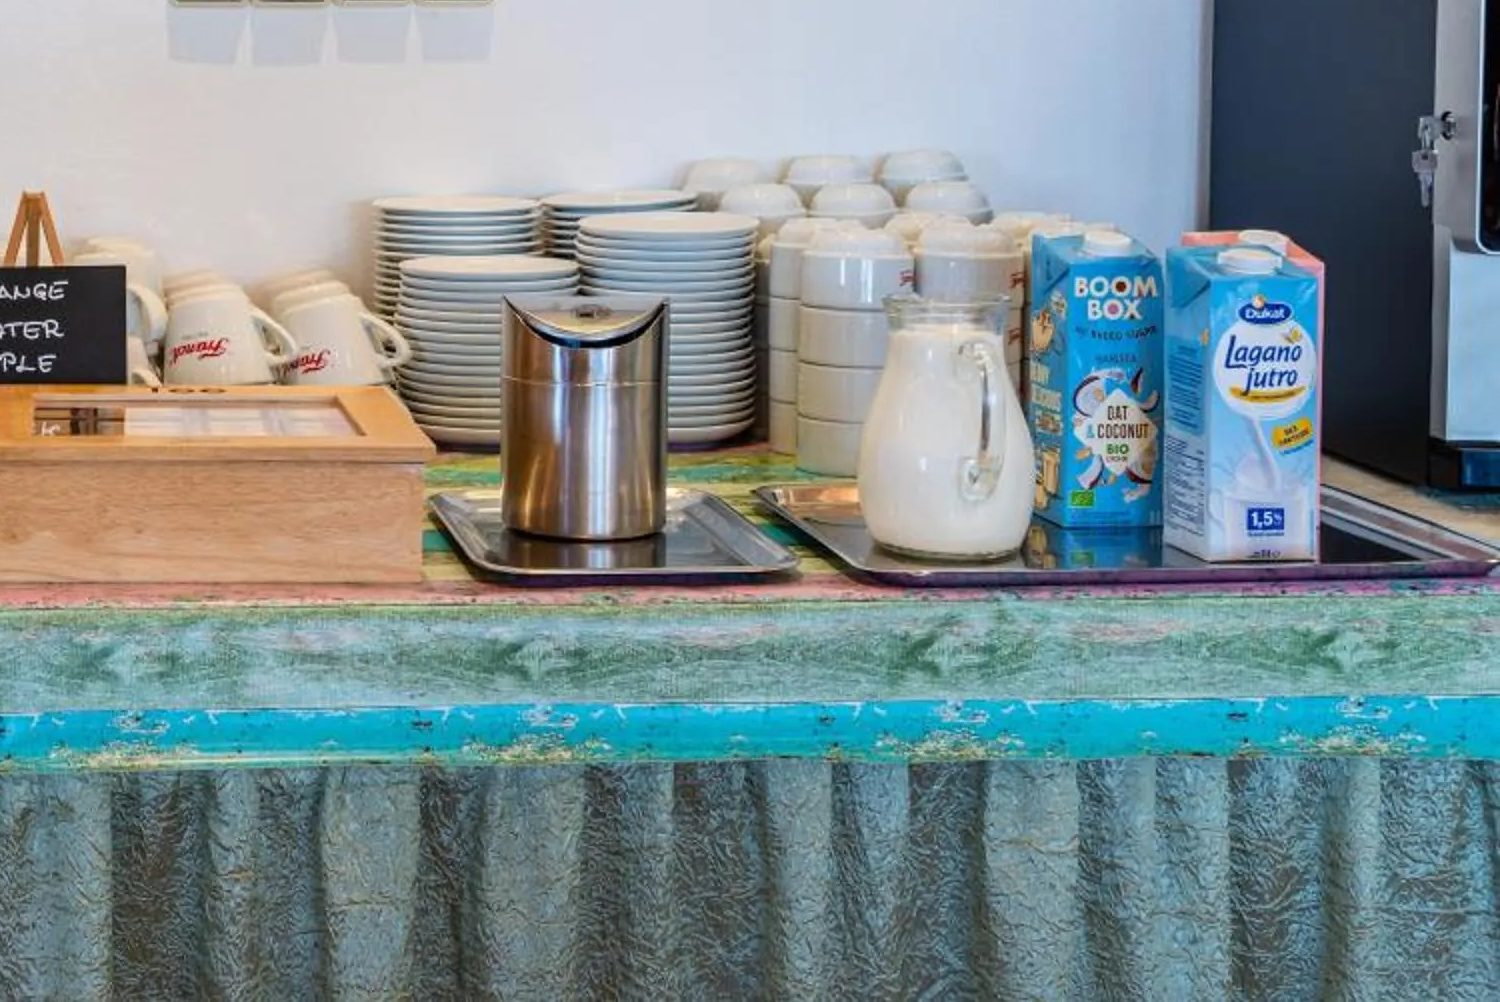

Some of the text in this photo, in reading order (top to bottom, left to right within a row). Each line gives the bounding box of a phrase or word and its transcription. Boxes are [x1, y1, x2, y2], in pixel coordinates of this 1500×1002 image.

[1075, 276, 1158, 299] BOOM
[1087, 299, 1143, 321] BOX
[1245, 309, 1285, 319] Dukat
[1224, 334, 1302, 369] Lagano
[1241, 367, 1298, 396] jutro
[1107, 405, 1129, 420] OAT
[1097, 423, 1149, 439] COCONUT
[1107, 444, 1129, 455] BIO
